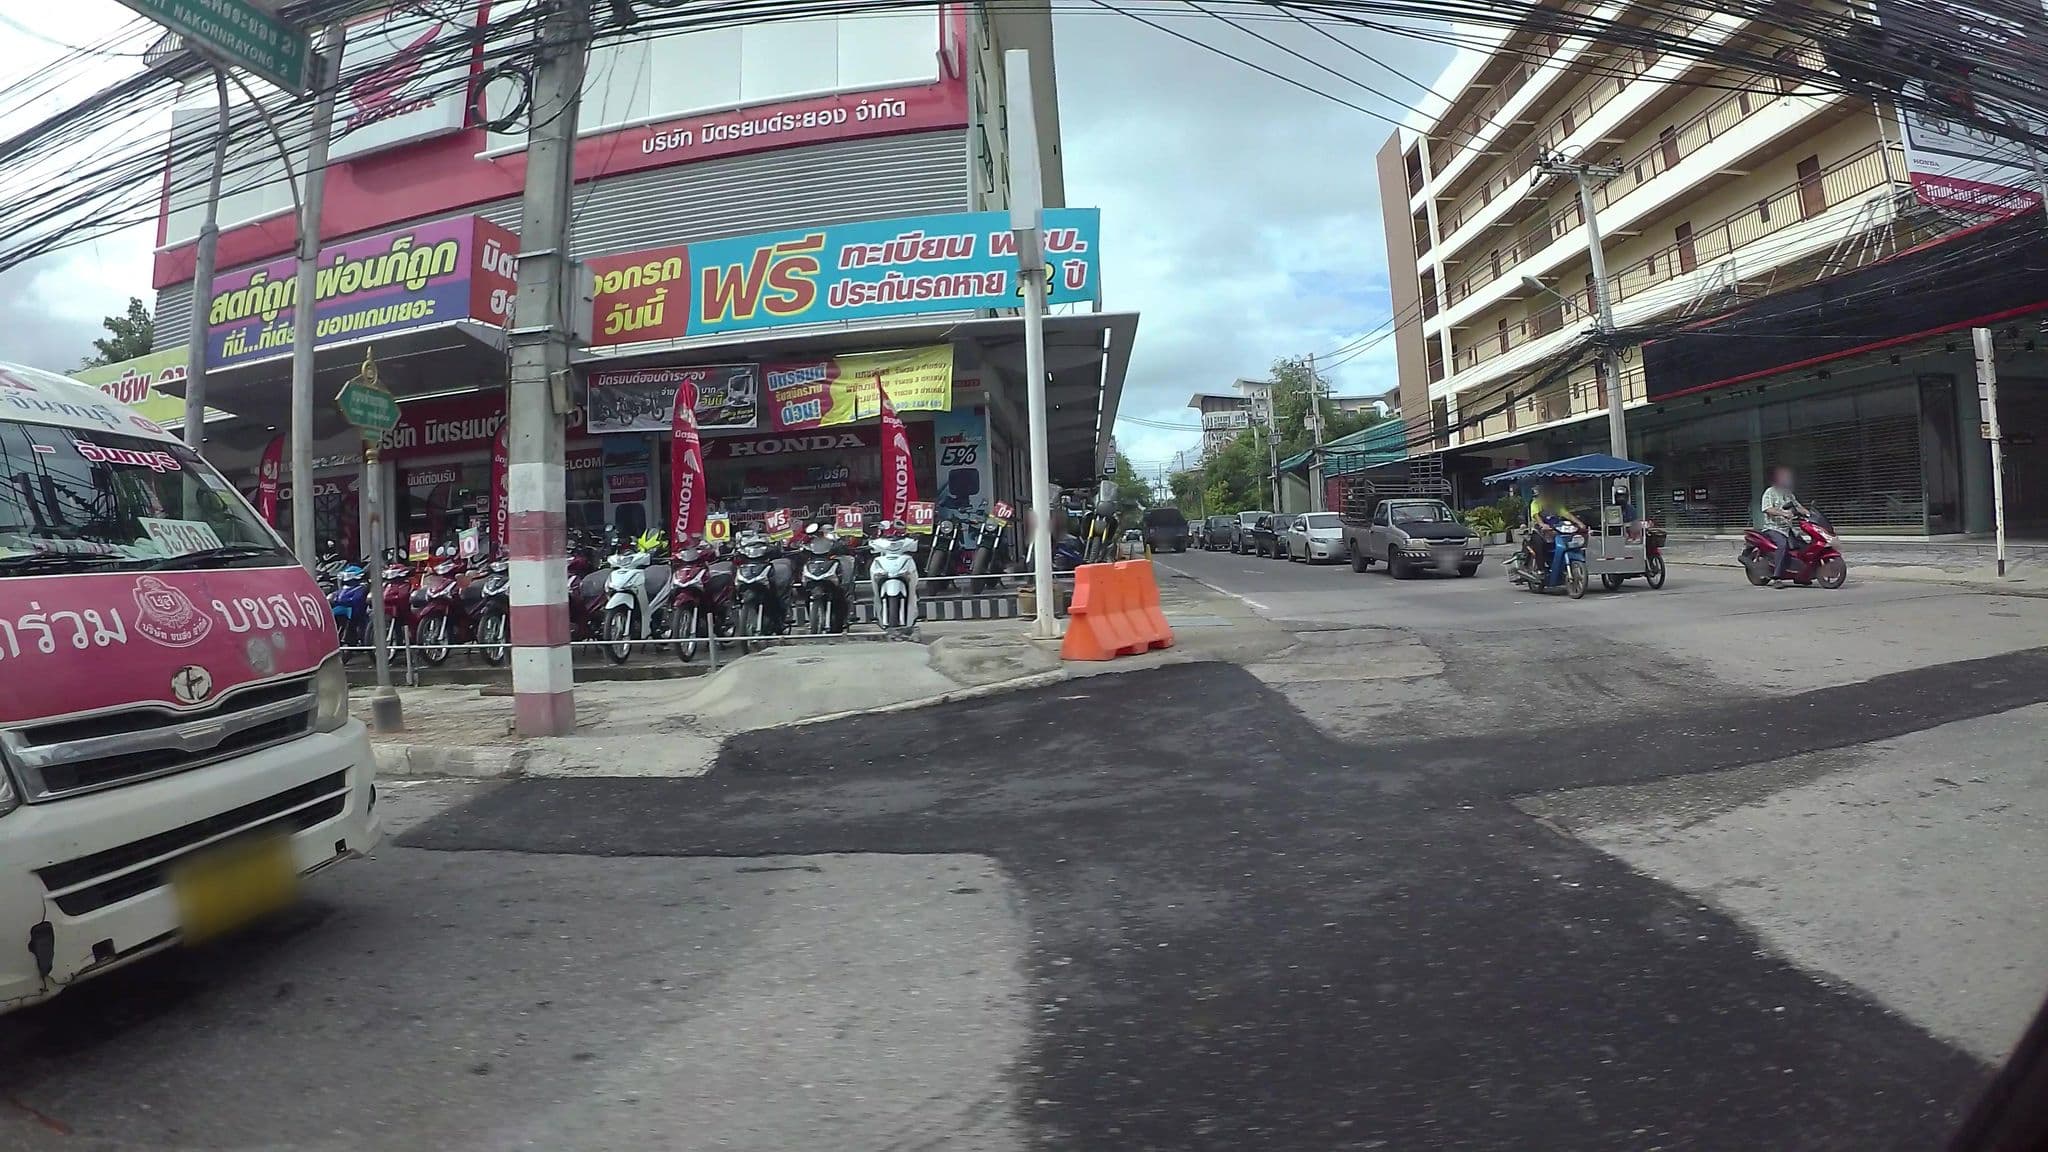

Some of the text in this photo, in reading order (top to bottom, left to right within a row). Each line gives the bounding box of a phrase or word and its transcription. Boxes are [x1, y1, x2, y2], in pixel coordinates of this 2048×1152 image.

[174, 5, 289, 78] NAKORNRAYONG 2
[642, 96, 906, 155] บริษัท มิตรยนต์ระยอง จำกัด
[840, 227, 1087, 269] ทะเบียน พบ.
[703, 233, 825, 322] ฟรี
[828, 270, 1006, 308] ประกันรถหาย
[1063, 259, 1087, 290] ปี
[316, 299, 436, 338] ของแถมเยอะ
[604, 287, 669, 335] วันนี้
[782, 400, 822, 425] ด่วน!
[73, 438, 182, 473] จันทบุรี
[729, 433, 866, 457] HONDA
[942, 445, 977, 466] 5%
